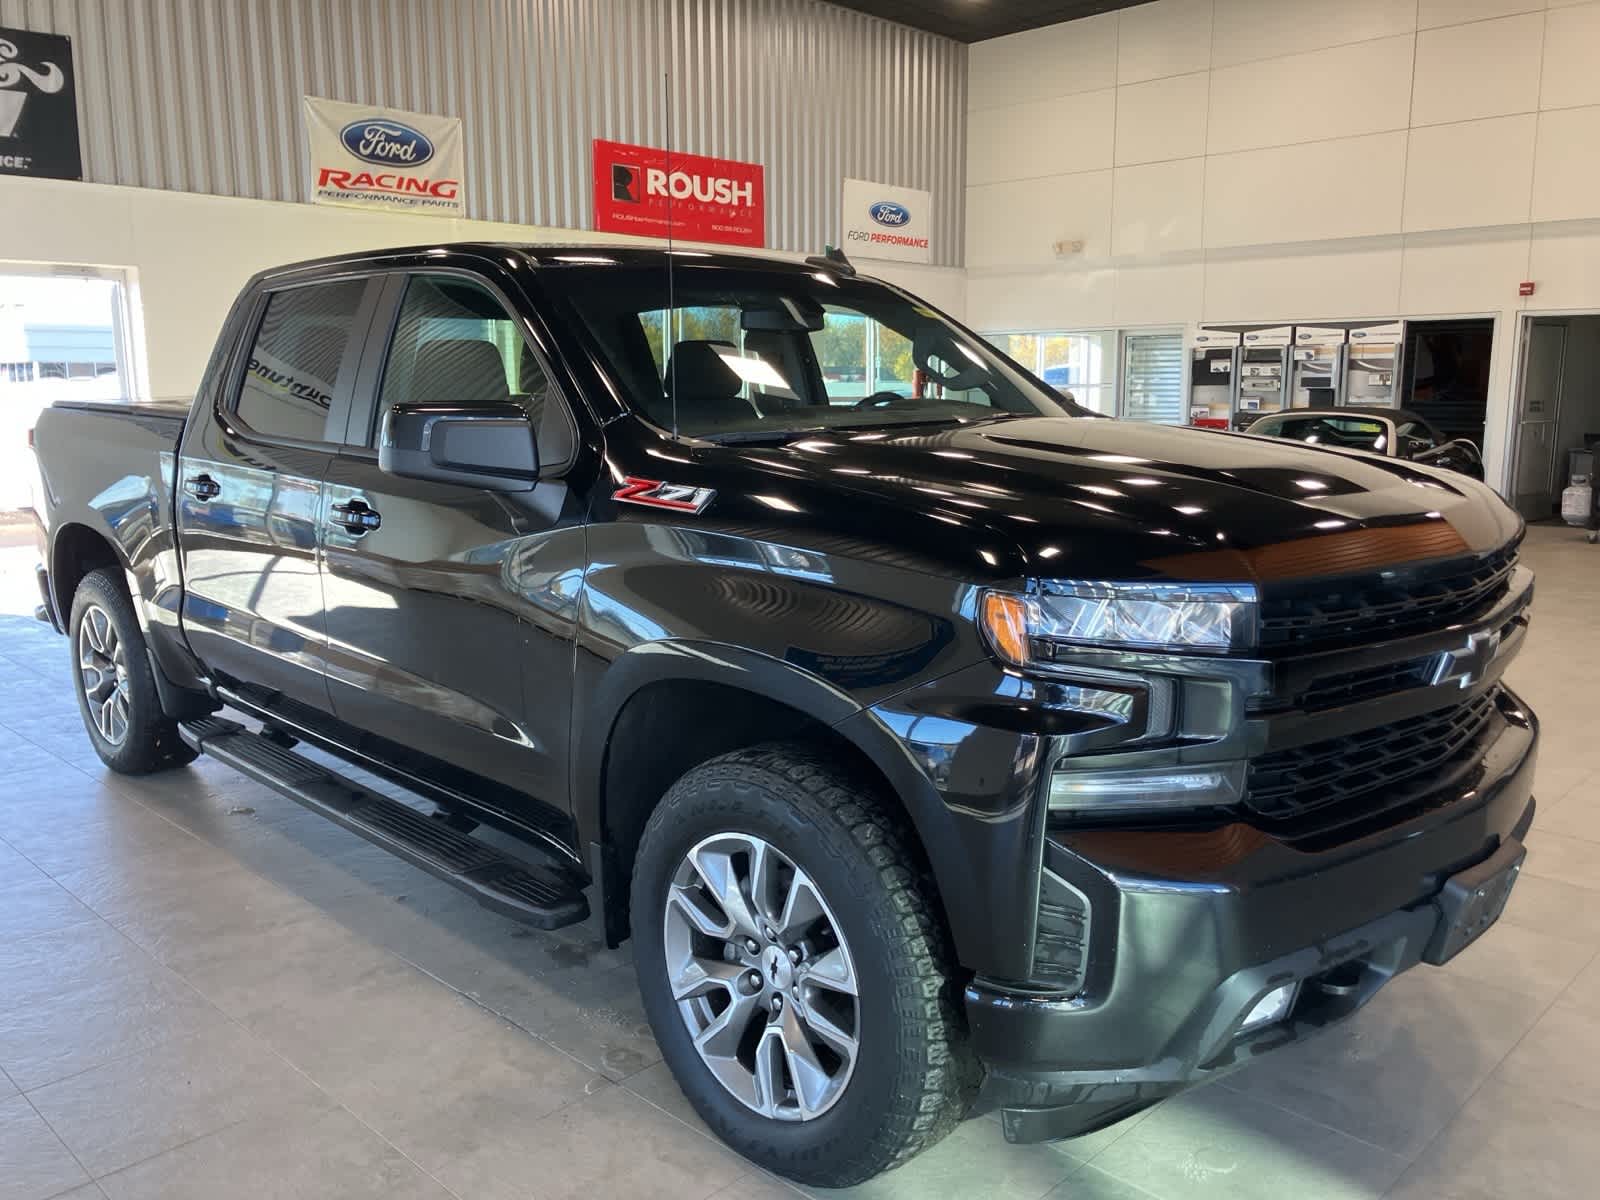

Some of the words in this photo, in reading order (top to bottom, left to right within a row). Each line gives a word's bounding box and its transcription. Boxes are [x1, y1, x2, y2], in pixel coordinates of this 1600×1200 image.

[359, 125, 417, 161] Ford
[318, 168, 458, 199] RACING
[318, 190, 418, 205] PERFORMANCE
[422, 199, 460, 208] PARTS
[647, 168, 753, 207] ROUSH
[877, 205, 903, 223] Ford
[848, 230, 870, 241] FORD
[870, 233, 929, 249] PERFORMANCE
[609, 475, 718, 515] Z71
